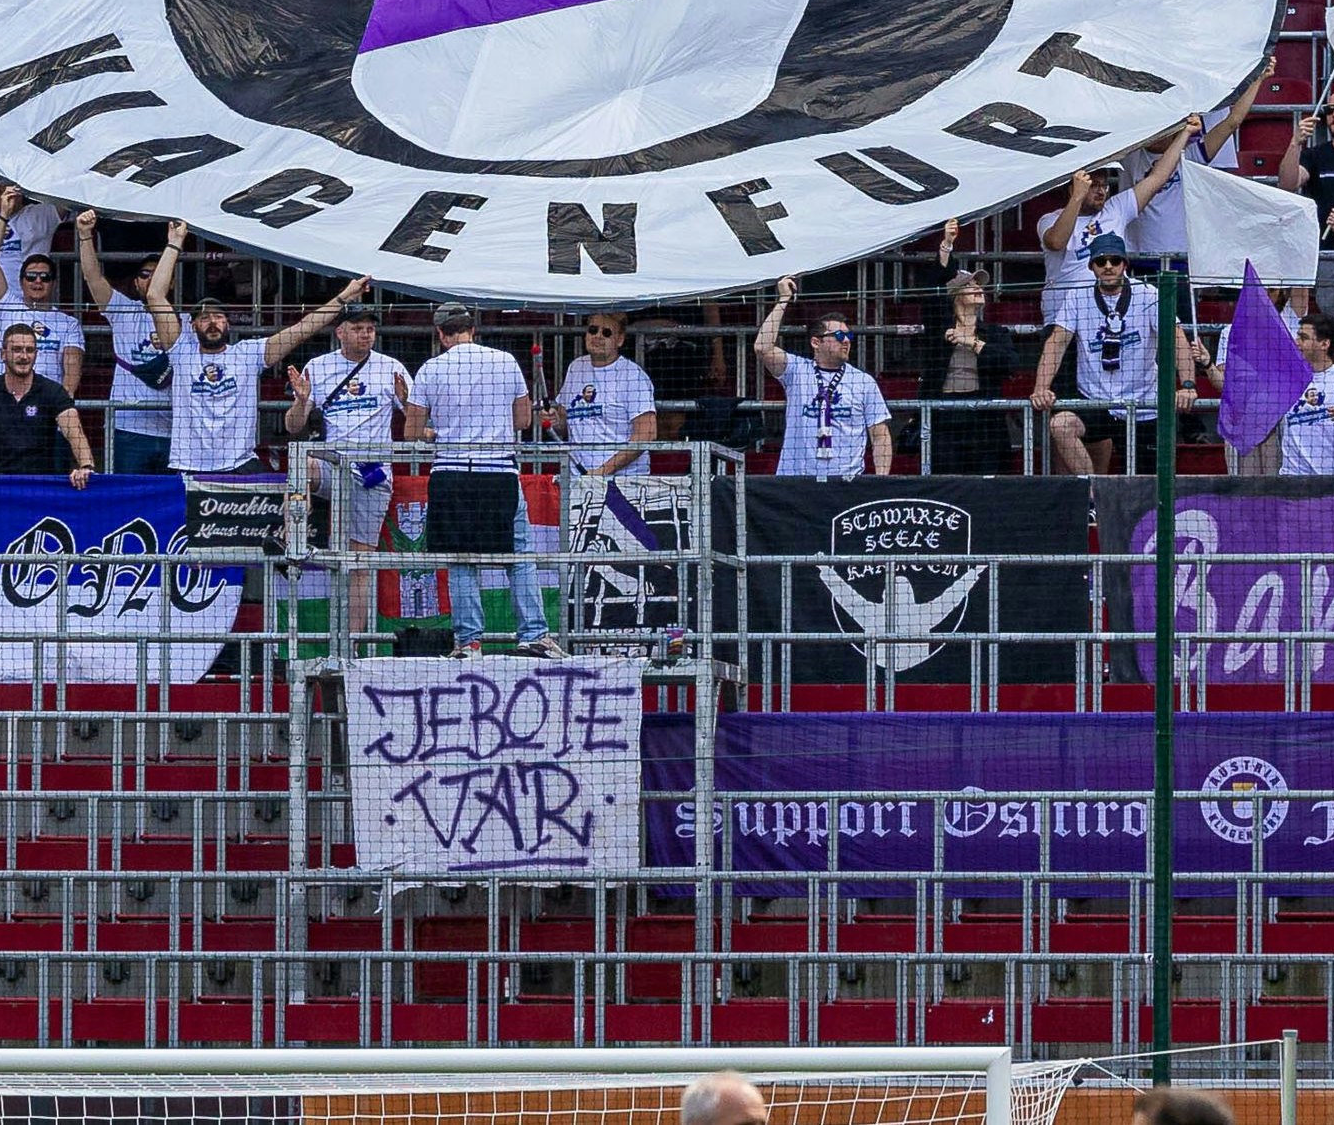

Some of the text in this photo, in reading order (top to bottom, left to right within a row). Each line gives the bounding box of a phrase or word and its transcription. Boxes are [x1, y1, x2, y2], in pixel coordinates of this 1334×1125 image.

[199, 496, 313, 516] Durchhal
[841, 505, 961, 535] SCHWARZE
[241, 524, 271, 538] und
[865, 530, 940, 552] SEELE
[364, 667, 636, 763] JEBOTE
[1208, 759, 1280, 789] AUSTRIA
[675, 786, 917, 846] Support
[1207, 812, 1282, 843] KLAGENURT
